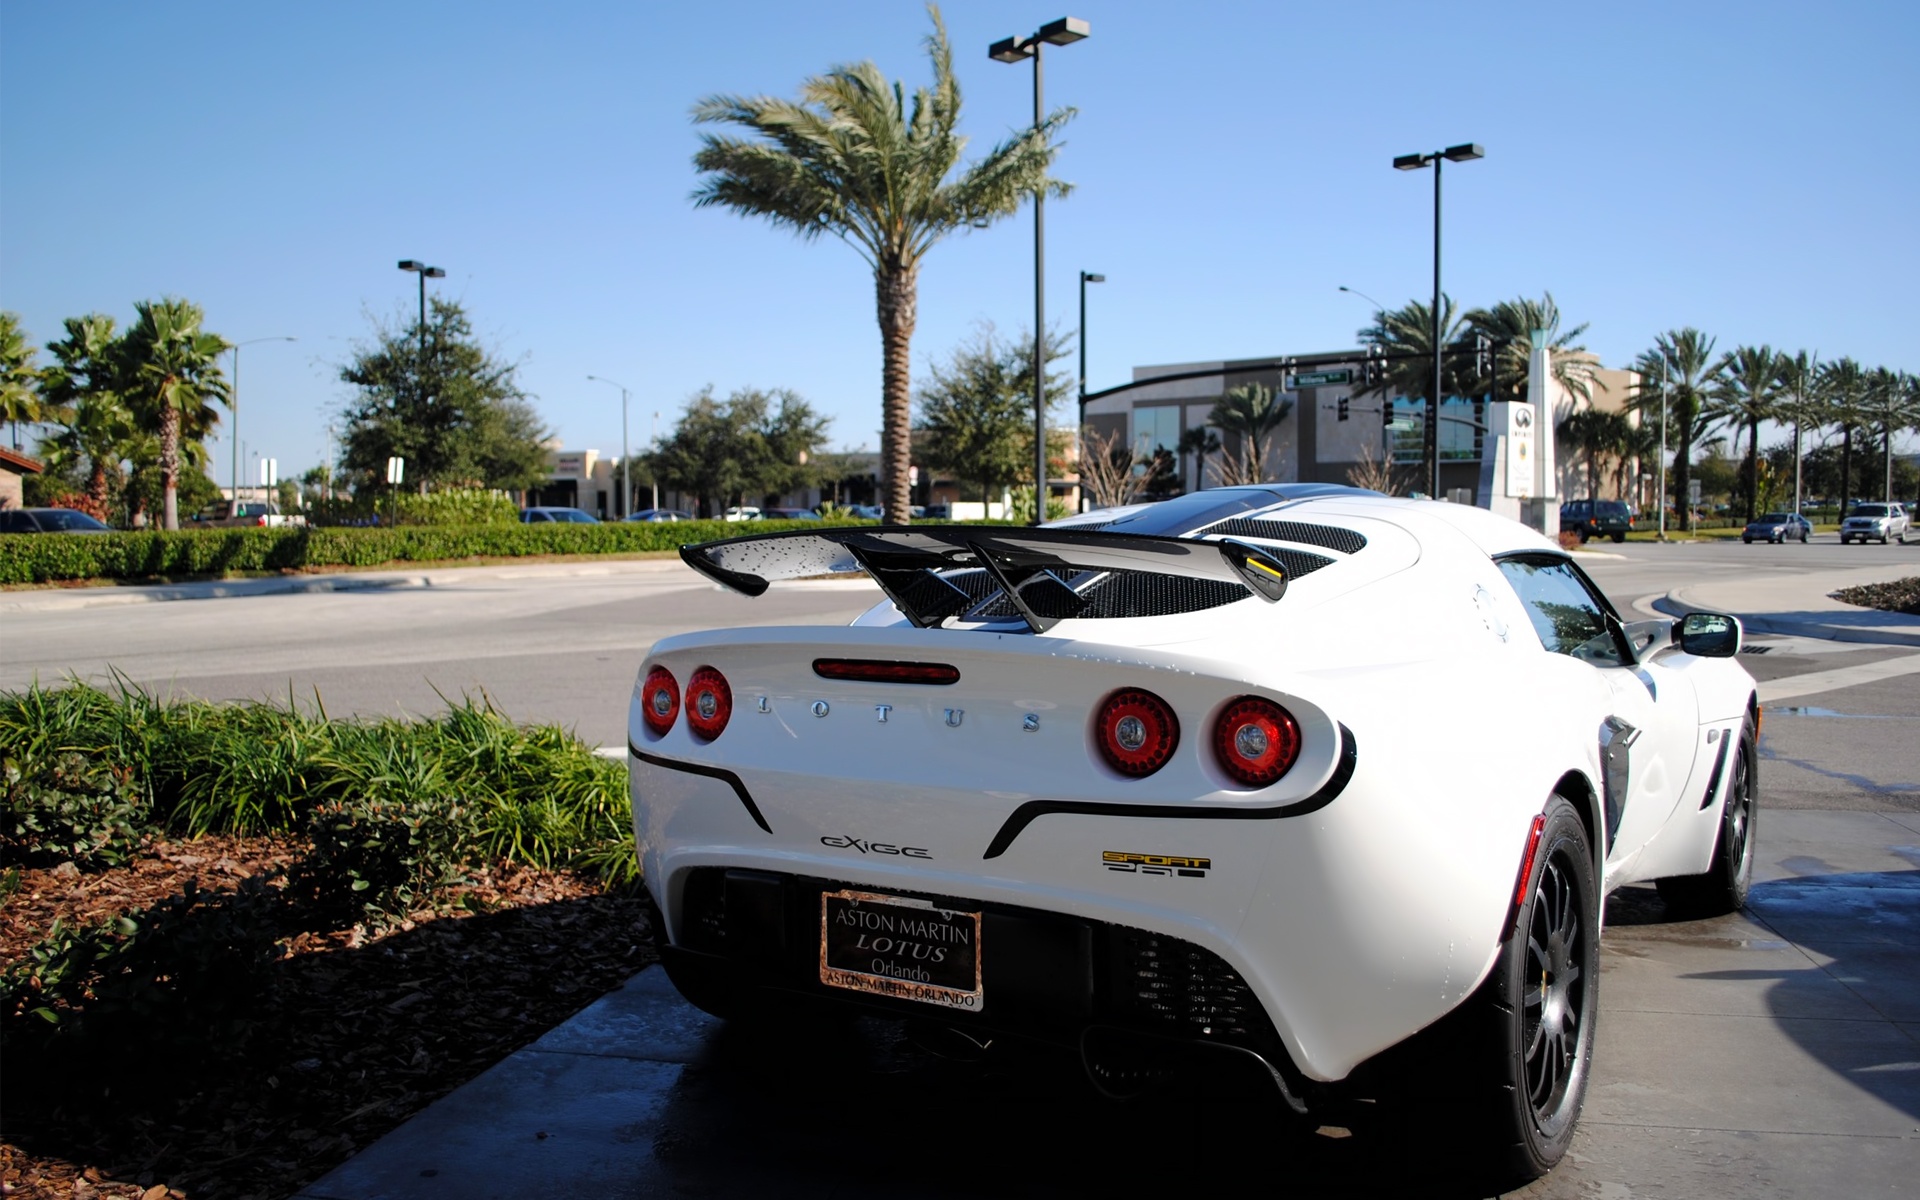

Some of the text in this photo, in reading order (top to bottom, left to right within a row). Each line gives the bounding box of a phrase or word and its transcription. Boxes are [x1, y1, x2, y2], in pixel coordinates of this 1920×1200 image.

[758, 696, 1040, 732] LOTUS
[1102, 851, 1211, 869] SPORT
[835, 908, 969, 945] ASTON MARTIN
[855, 934, 948, 963] LOTUS
[871, 957, 931, 983] Orlando
[826, 971, 975, 1007] ASTON MARTIN ORLANDO
